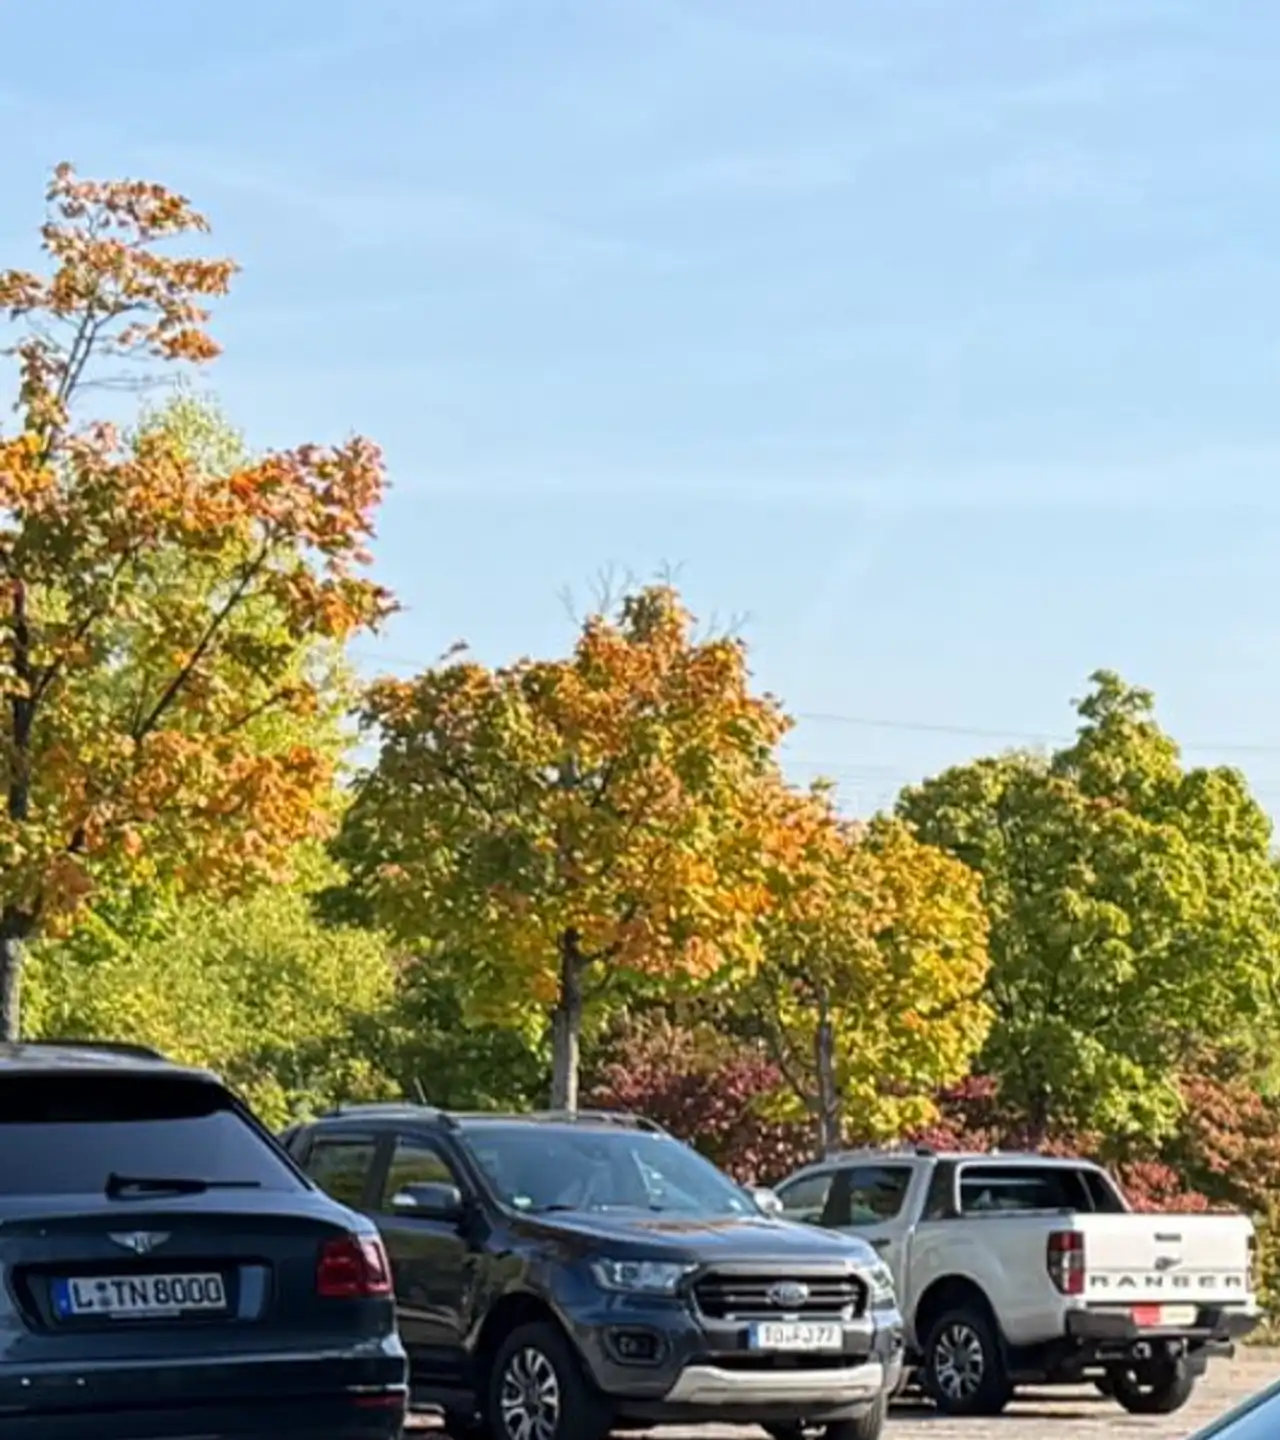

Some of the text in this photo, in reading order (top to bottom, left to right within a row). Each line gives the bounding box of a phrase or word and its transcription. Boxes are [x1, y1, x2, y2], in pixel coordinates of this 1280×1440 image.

[73, 1277, 223, 1309] L TN 8000
[1090, 1275, 1243, 1289] RANGER
